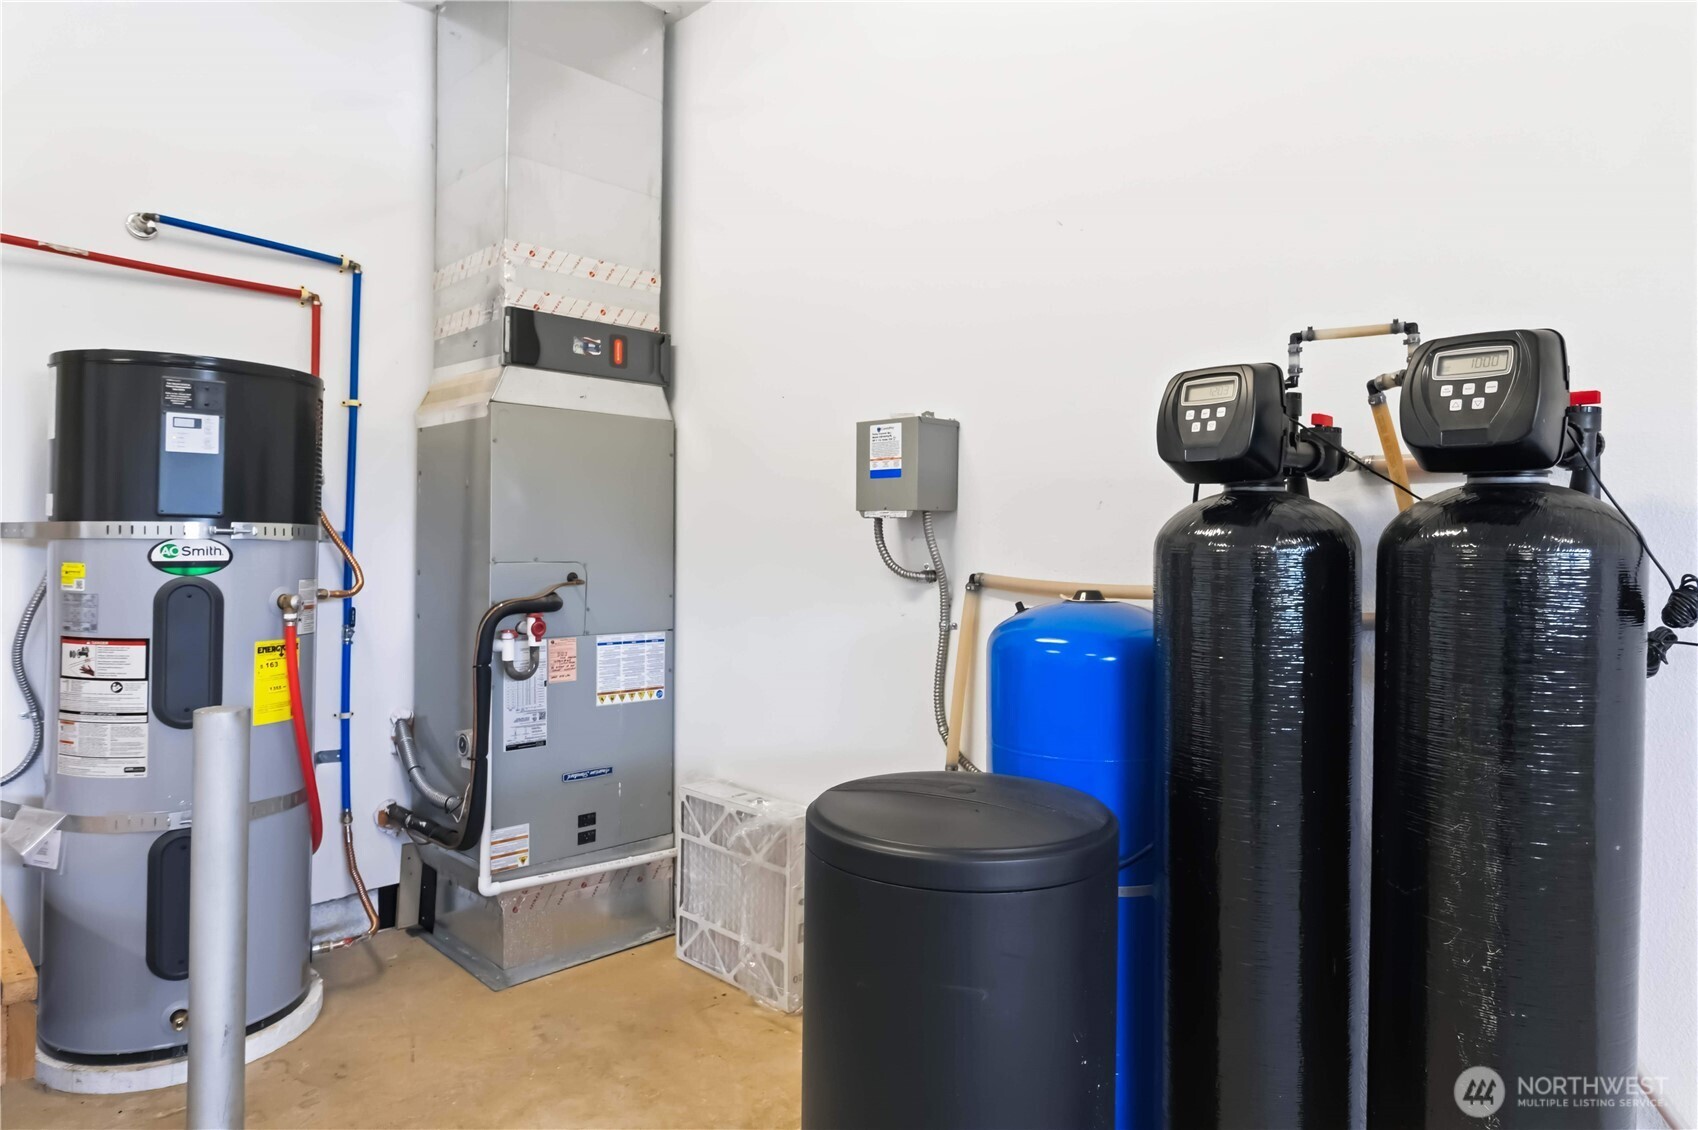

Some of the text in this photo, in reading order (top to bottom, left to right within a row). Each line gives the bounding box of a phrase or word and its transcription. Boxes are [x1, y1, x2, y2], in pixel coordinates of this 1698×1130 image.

[1471, 354, 1500, 369] 1000
[161, 545, 222, 557] AO Smith
[266, 661, 279, 669] 163
